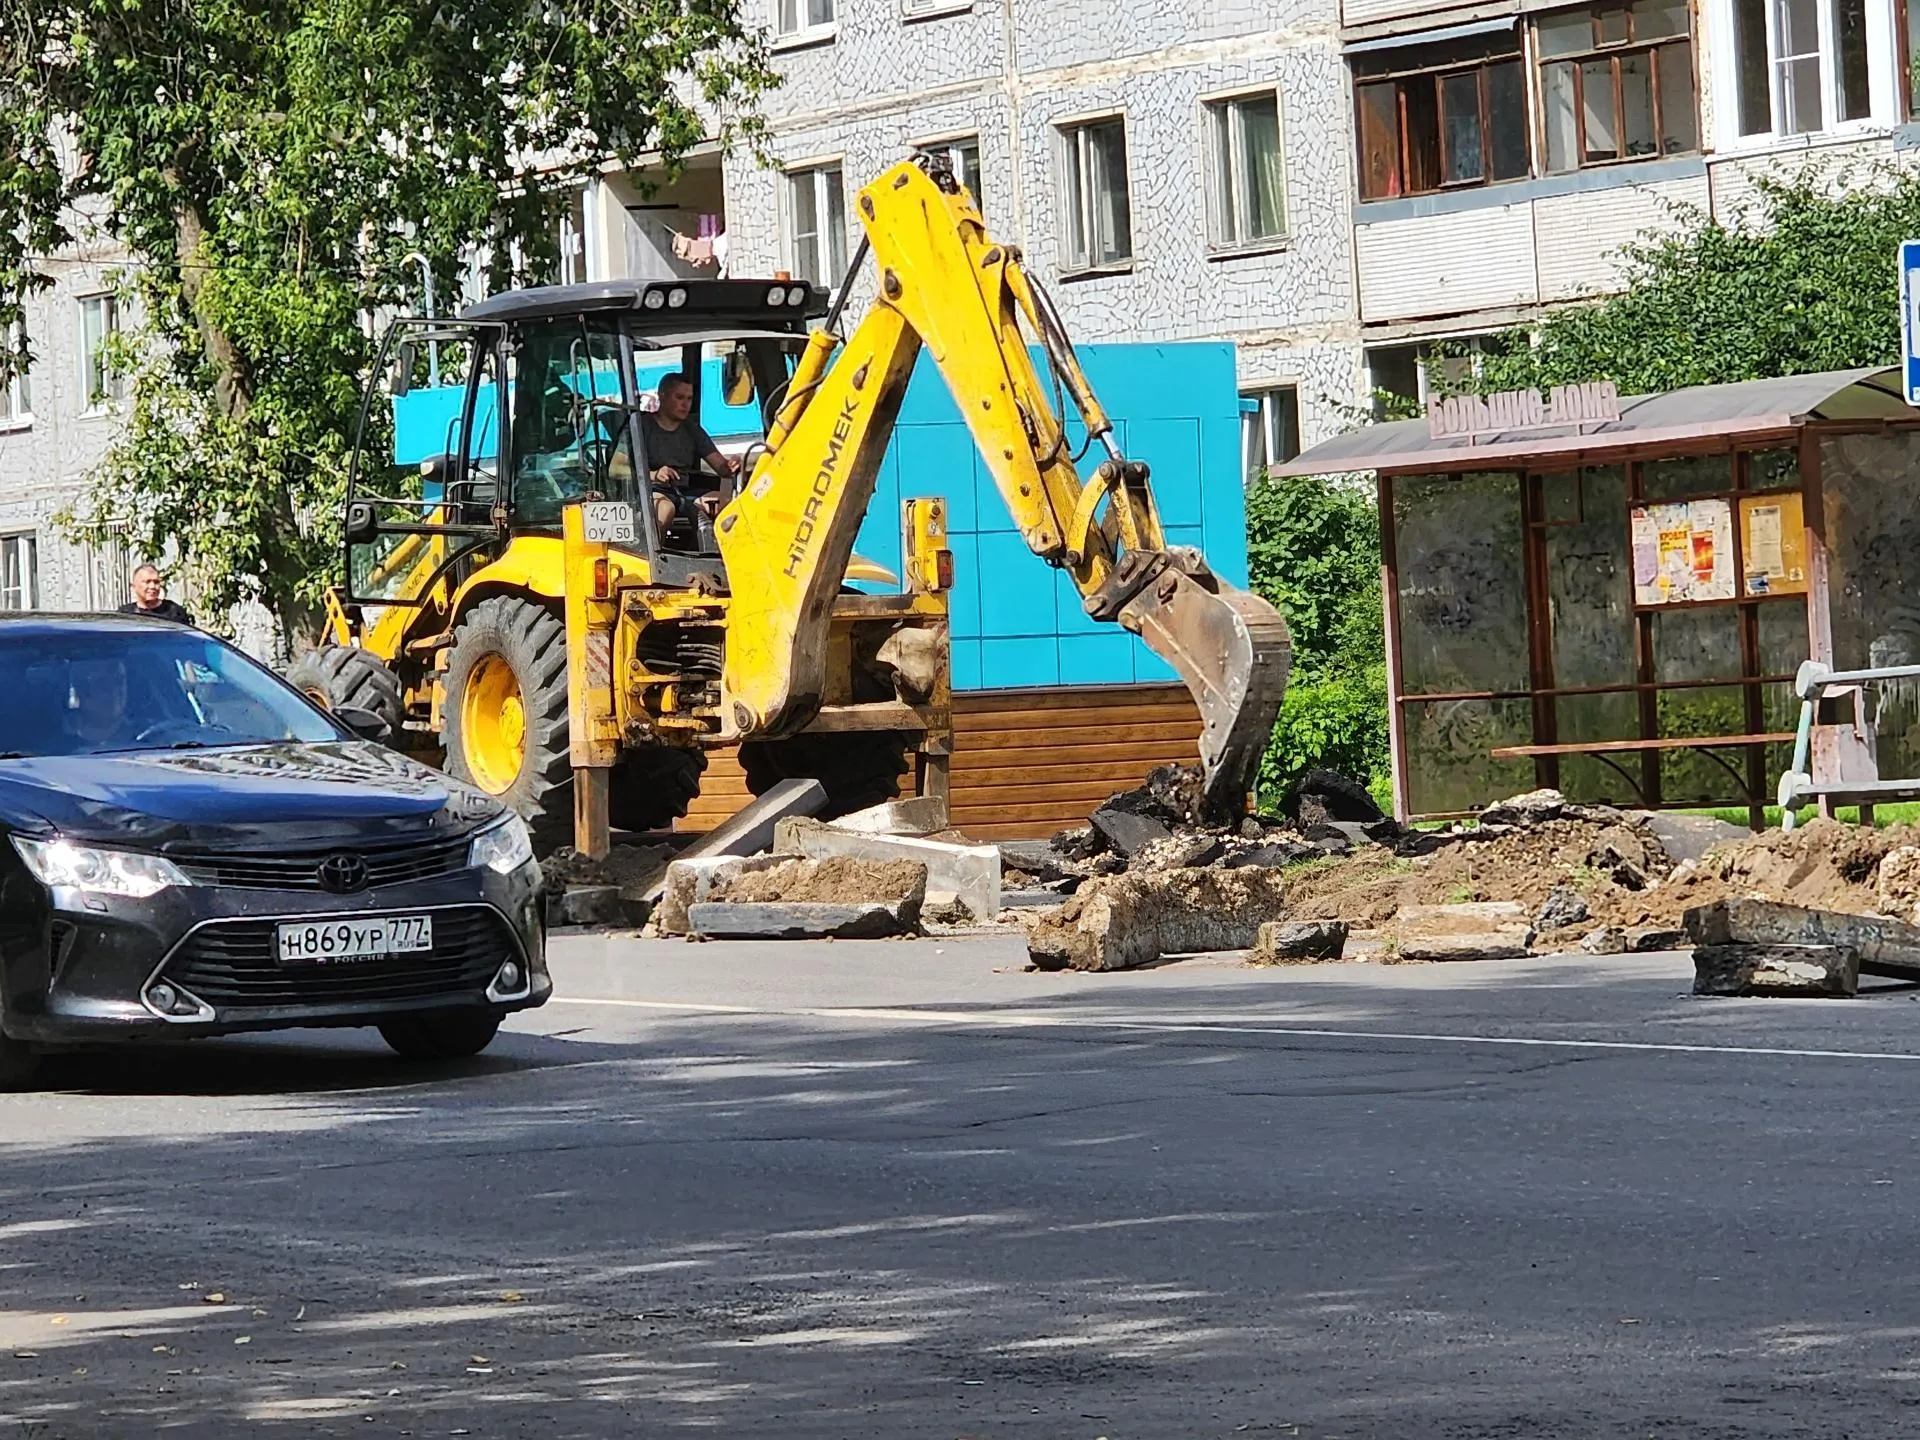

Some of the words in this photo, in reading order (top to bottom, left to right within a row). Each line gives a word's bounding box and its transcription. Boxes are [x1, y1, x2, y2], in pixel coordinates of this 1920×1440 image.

[590, 506, 627, 522] 4210
[616, 527, 630, 539] 50
[388, 918, 424, 942] 777
[397, 940, 415, 949] RUS
